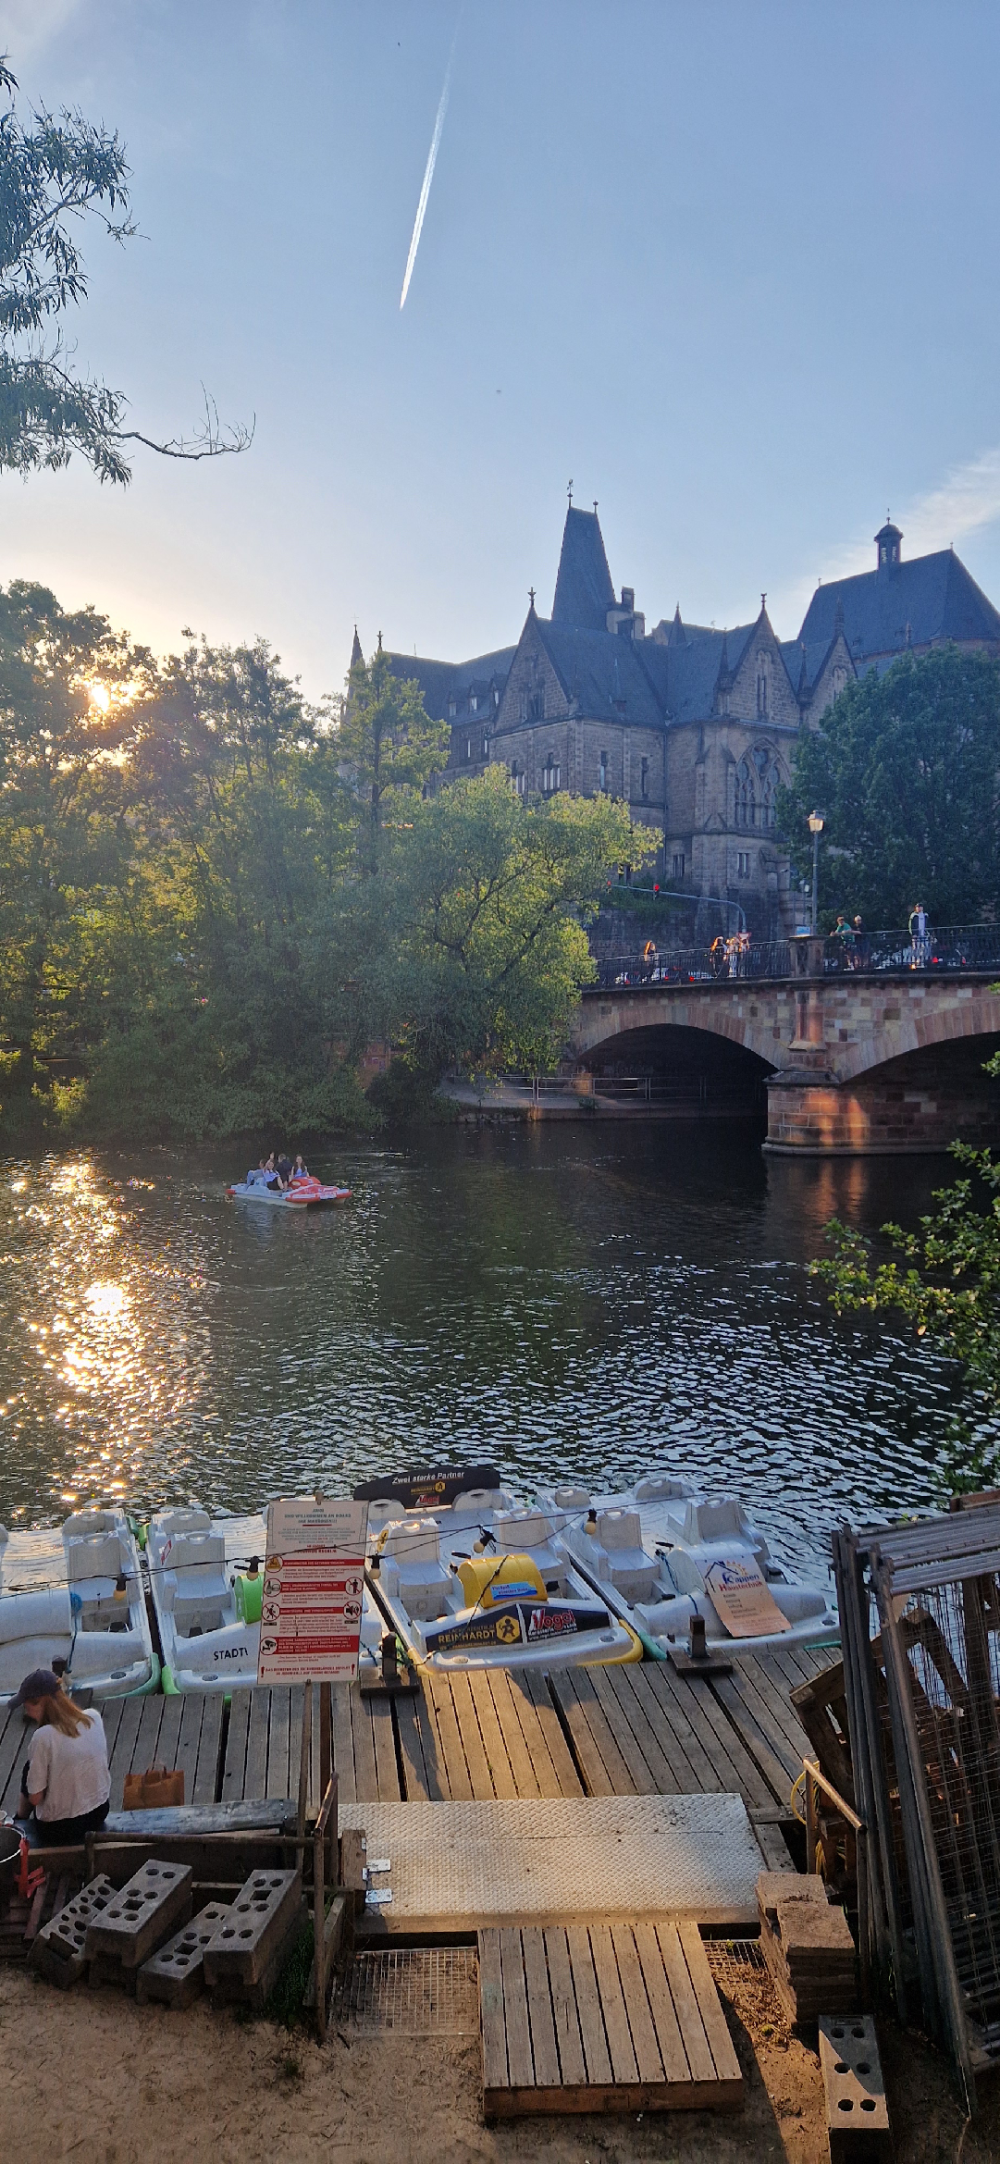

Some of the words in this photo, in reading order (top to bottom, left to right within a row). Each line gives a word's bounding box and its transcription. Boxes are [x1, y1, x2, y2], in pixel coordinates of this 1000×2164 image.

[392, 1475, 411, 1485] Zwei
[437, 1471, 465, 1479] Partner
[722, 1572, 760, 1584] Kappen
[718, 1581, 764, 1592] Haustechnik
[532, 1608, 576, 1631] Vogel
[438, 1629, 495, 1644] REINHARDT
